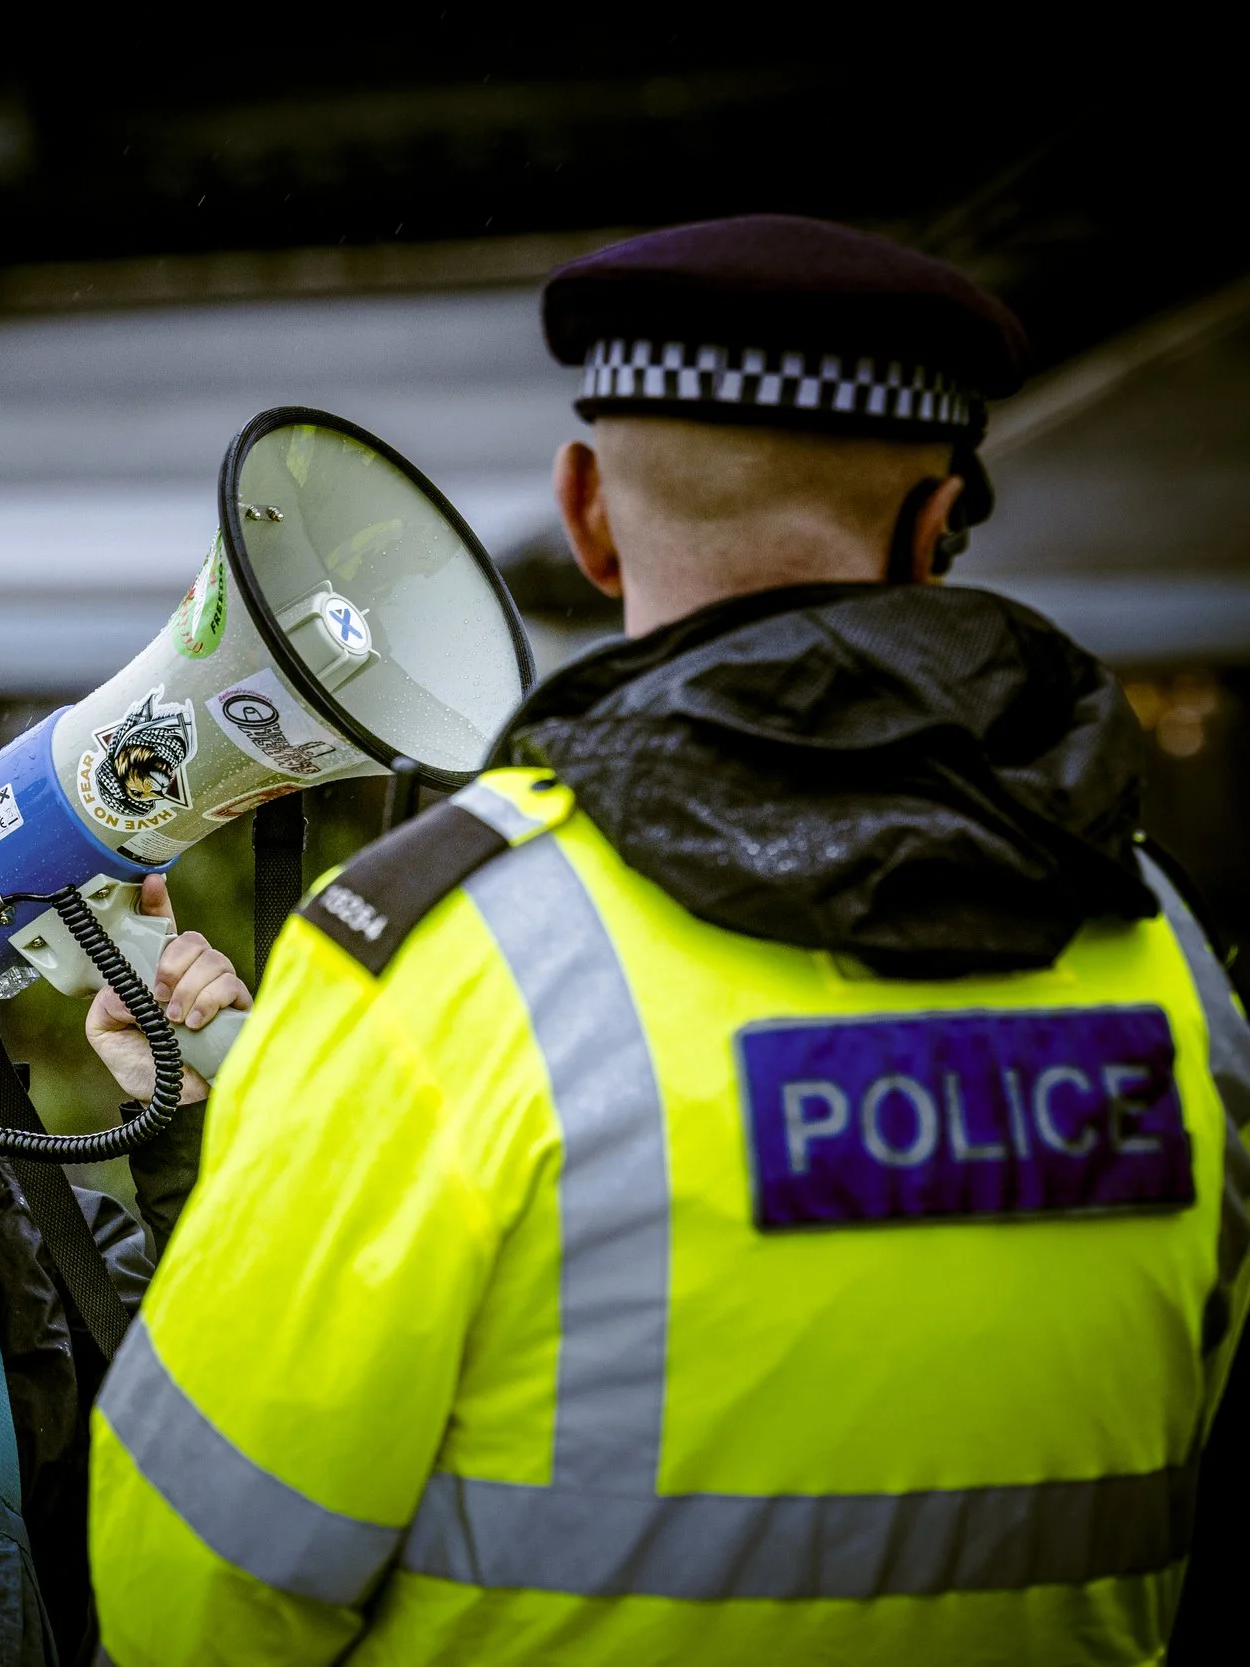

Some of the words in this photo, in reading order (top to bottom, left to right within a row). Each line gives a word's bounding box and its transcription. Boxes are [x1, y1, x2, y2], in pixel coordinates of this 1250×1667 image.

[80, 754, 96, 804] FEAR
[93, 806, 120, 828] NO
[124, 809, 173, 831] HAVE
[781, 1063, 1164, 1175] POLICE
